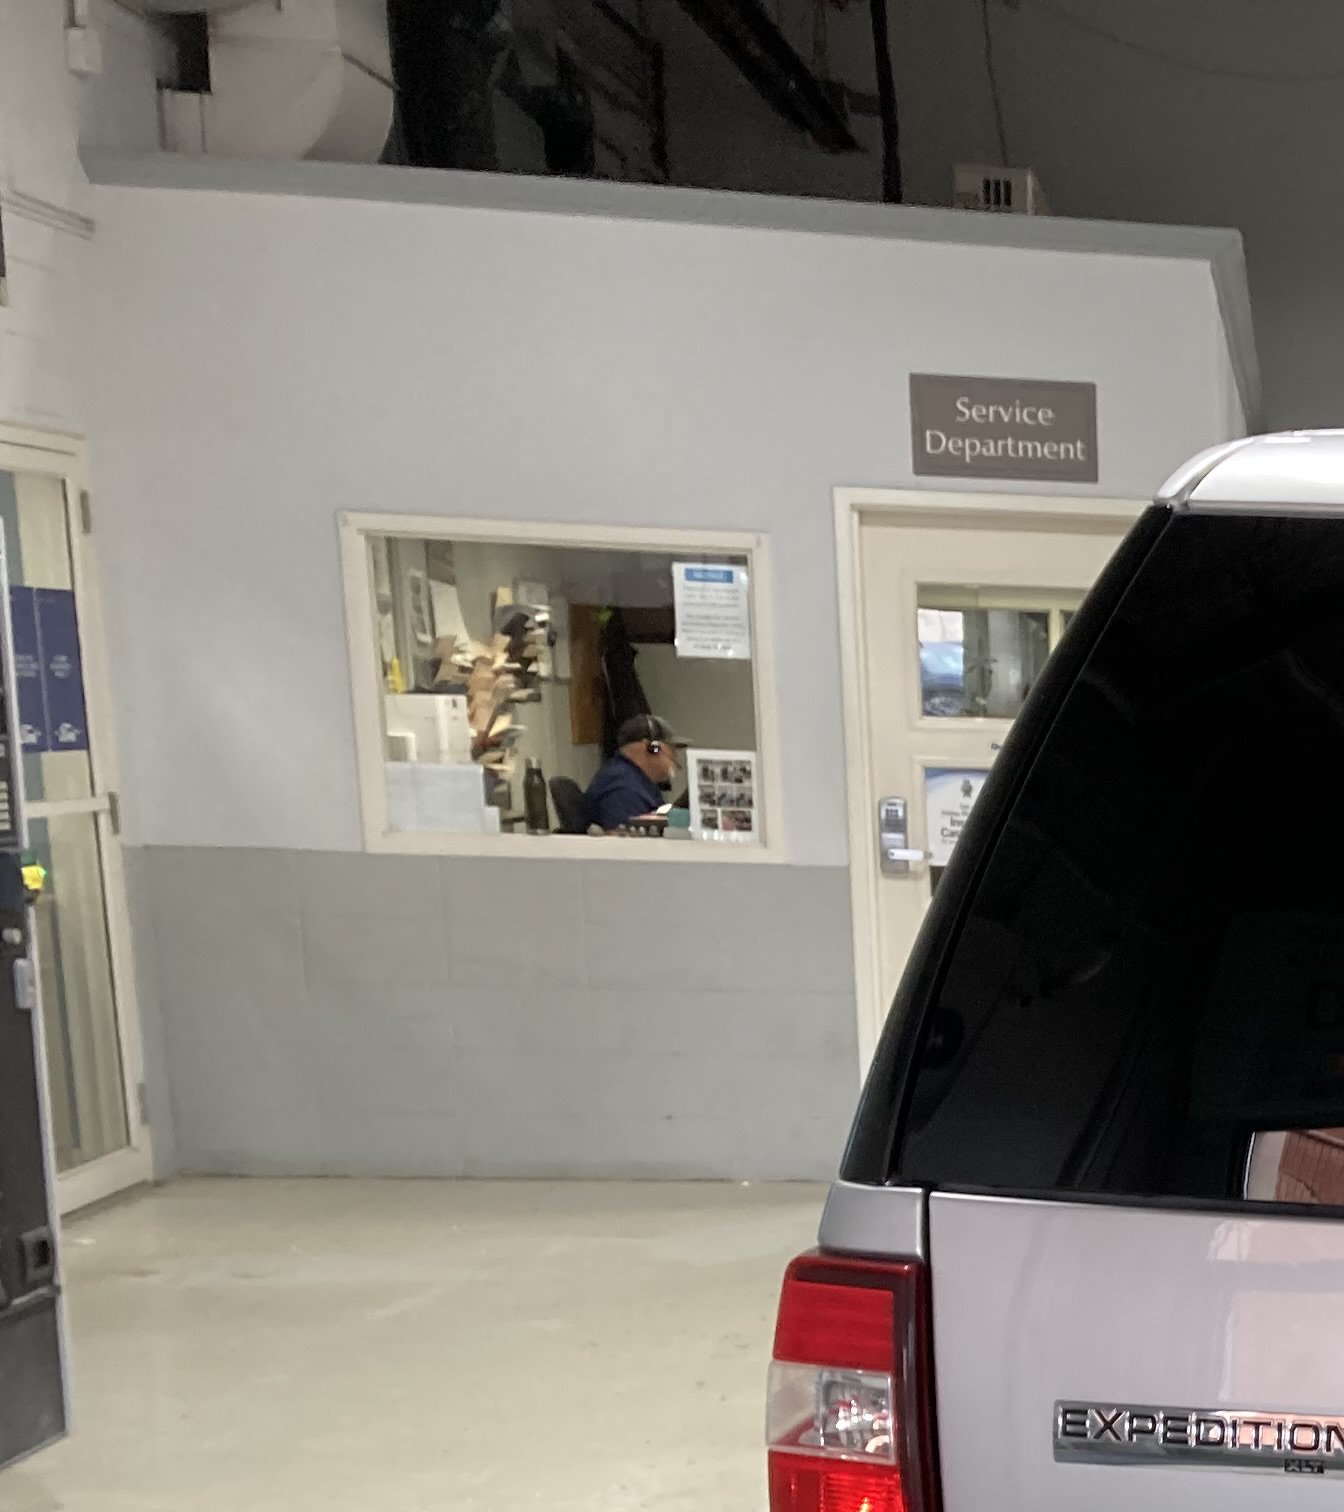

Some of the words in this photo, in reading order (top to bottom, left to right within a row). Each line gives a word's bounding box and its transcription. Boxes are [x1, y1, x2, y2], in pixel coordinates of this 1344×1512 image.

[955, 396, 1055, 426] Service
[925, 429, 1087, 464] Department
[1285, 1459, 1325, 1474] XLT
